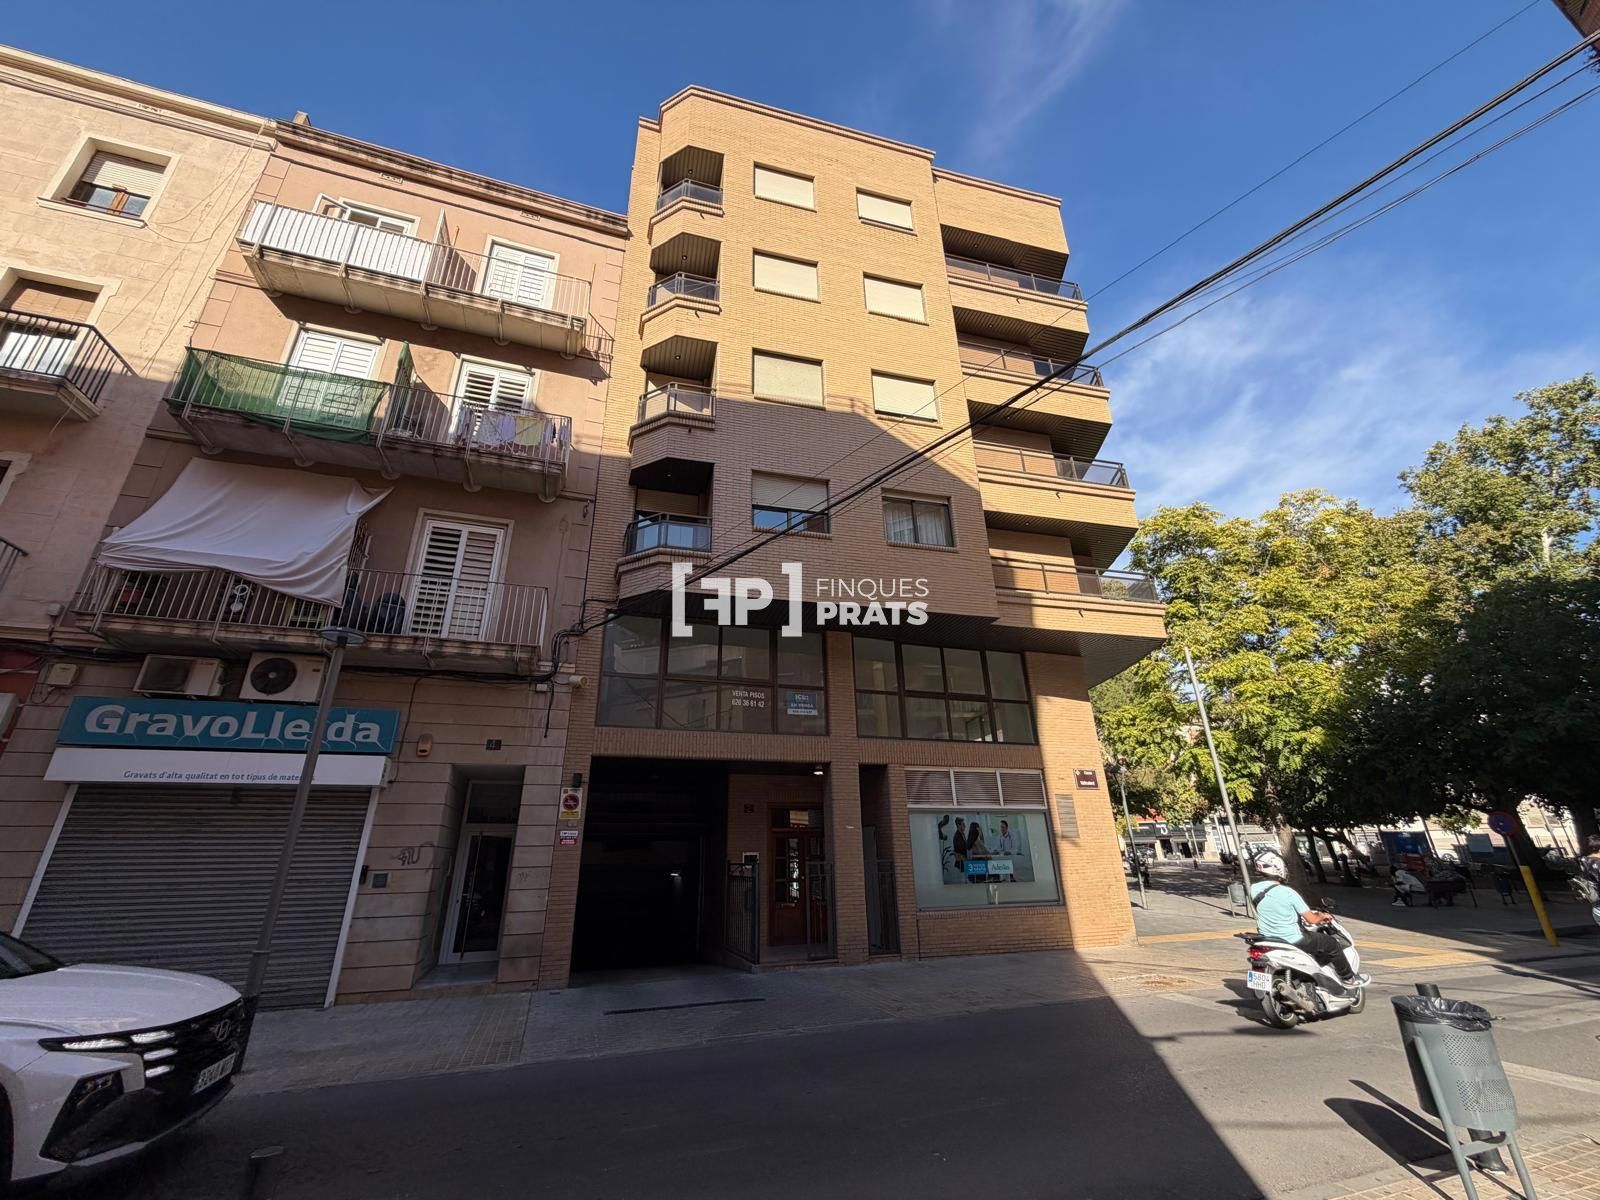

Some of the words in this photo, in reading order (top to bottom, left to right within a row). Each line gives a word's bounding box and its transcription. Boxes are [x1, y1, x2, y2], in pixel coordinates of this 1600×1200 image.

[85, 704, 380, 743] GravoLleda
[124, 770, 157, 779] Gravats
[158, 771, 182, 779] d'alta
[185, 772, 217, 781] qualitat
[246, 773, 266, 782] tipus
[268, 773, 277, 781] de
